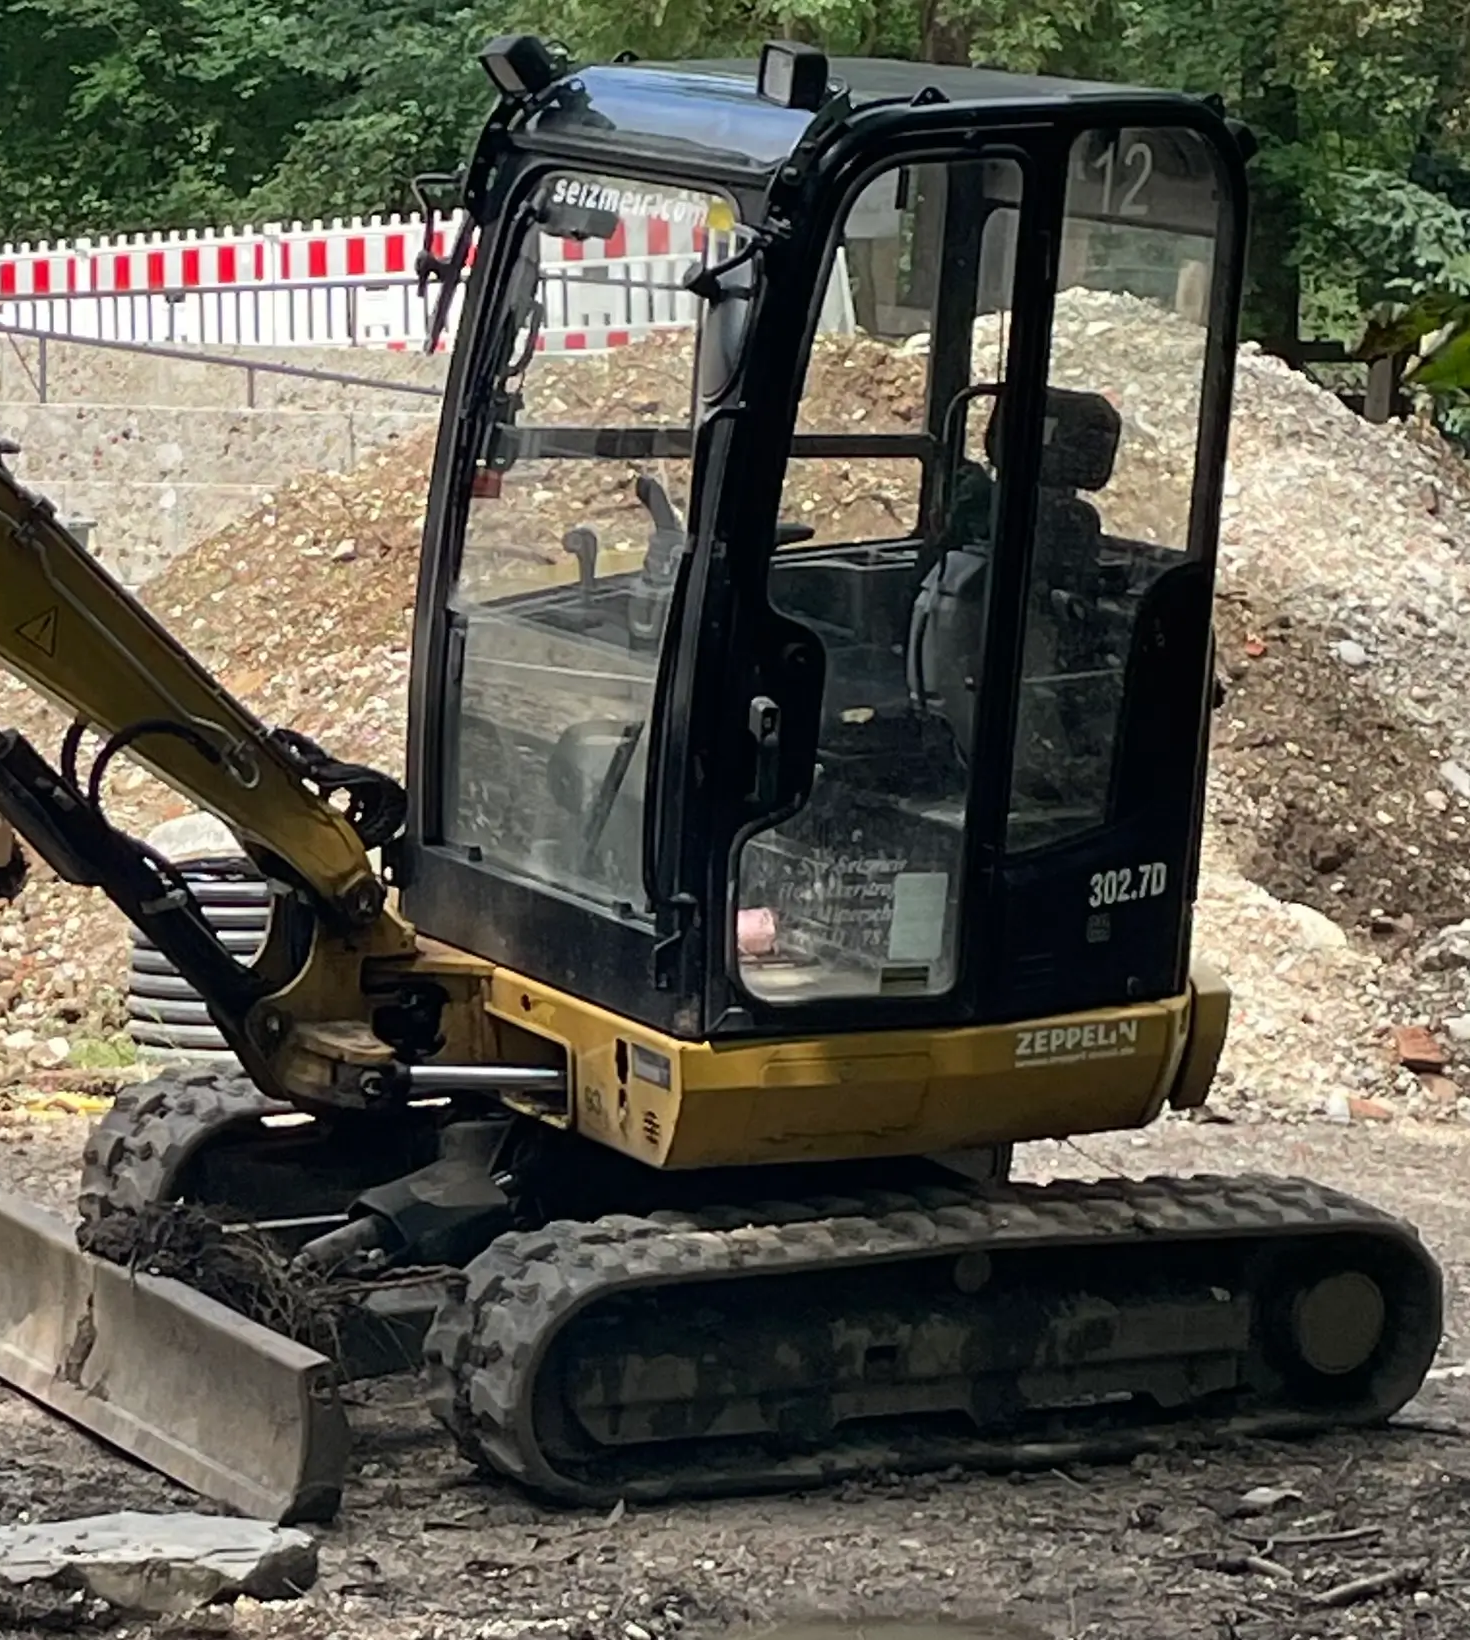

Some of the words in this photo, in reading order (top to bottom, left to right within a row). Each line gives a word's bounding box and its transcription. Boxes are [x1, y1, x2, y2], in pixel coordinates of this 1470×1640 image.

[1092, 141, 1152, 215] 12
[553, 178, 710, 227] seizmeir.com
[1088, 862, 1167, 908] 302.7D
[1015, 1020, 1138, 1056] ZEPPELIN
